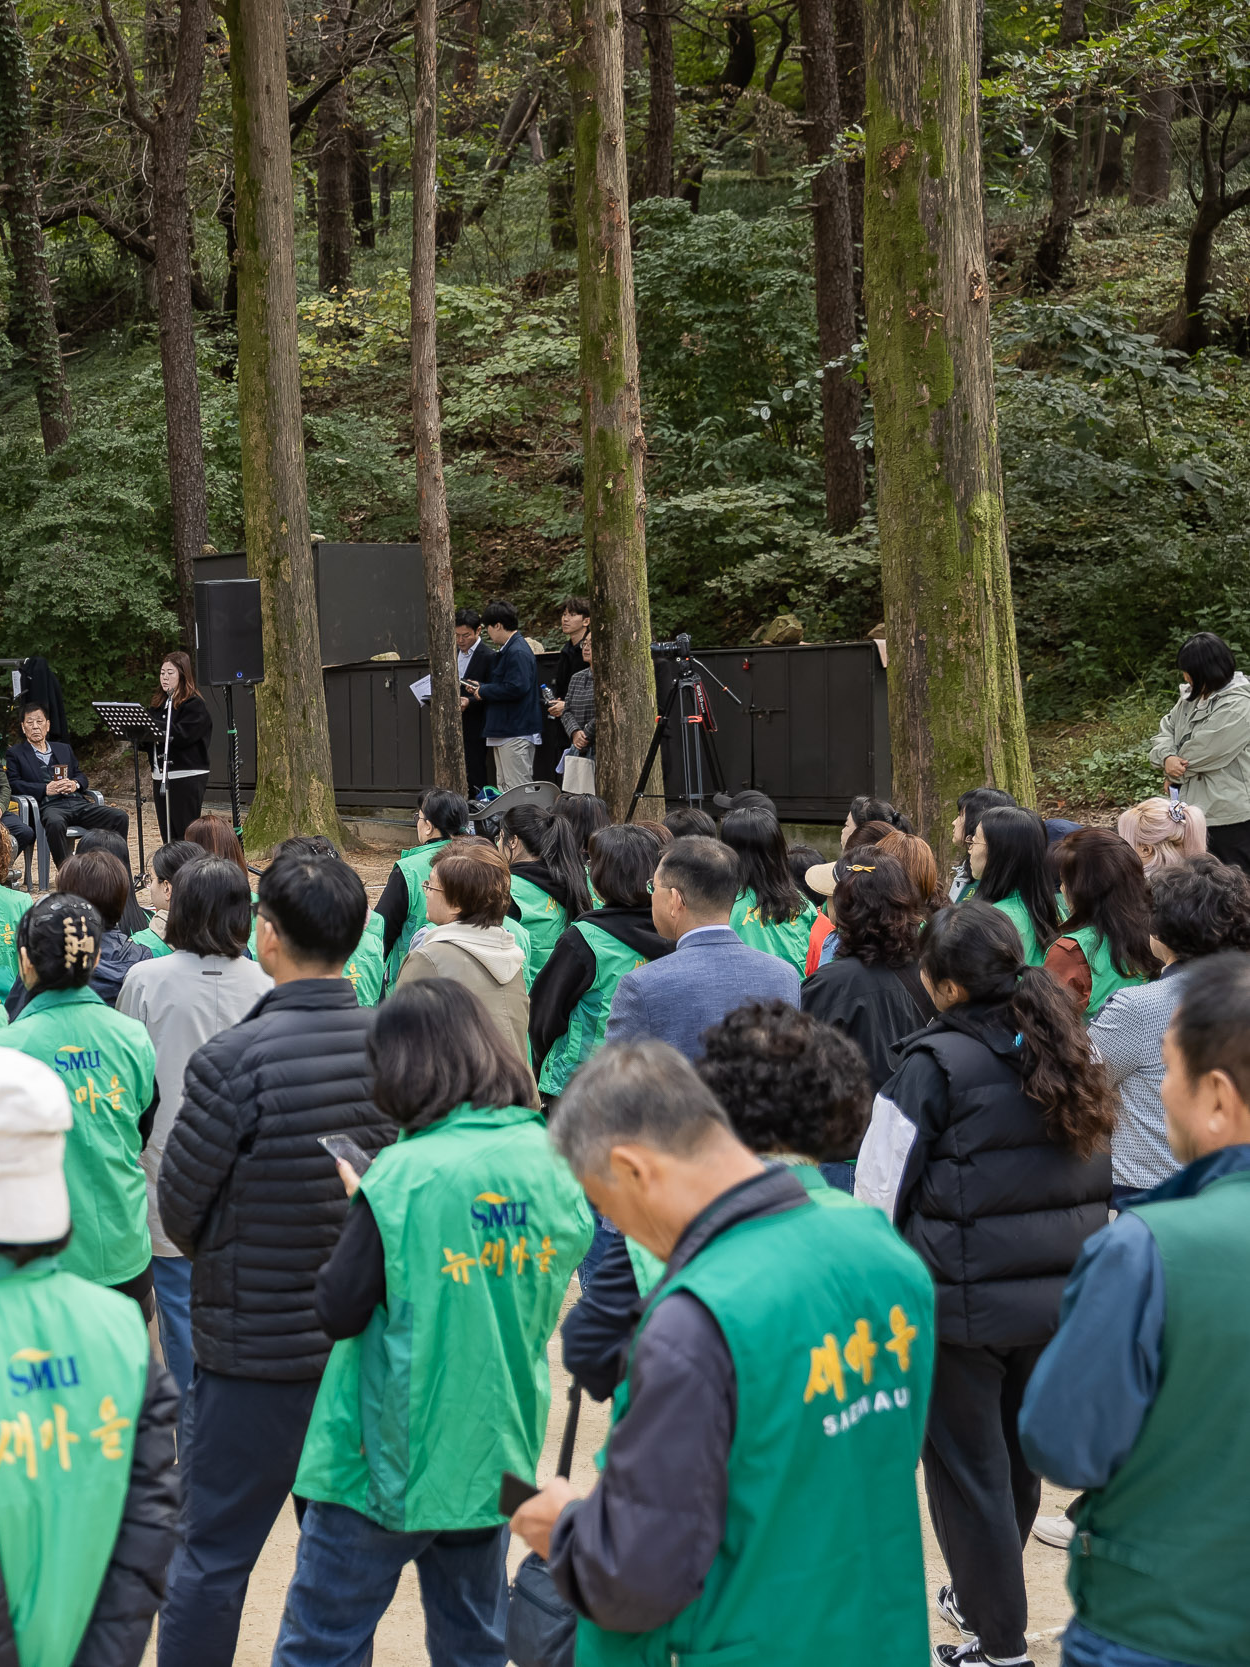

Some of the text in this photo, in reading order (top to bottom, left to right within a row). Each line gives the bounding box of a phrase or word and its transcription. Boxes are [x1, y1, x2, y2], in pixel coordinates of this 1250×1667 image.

[54, 1049, 101, 1073] SMU
[75, 1075, 128, 1114] 마을
[470, 1201, 528, 1230] SMU
[803, 1303, 917, 1403] 새마을
[6, 1352, 81, 1397] SMU
